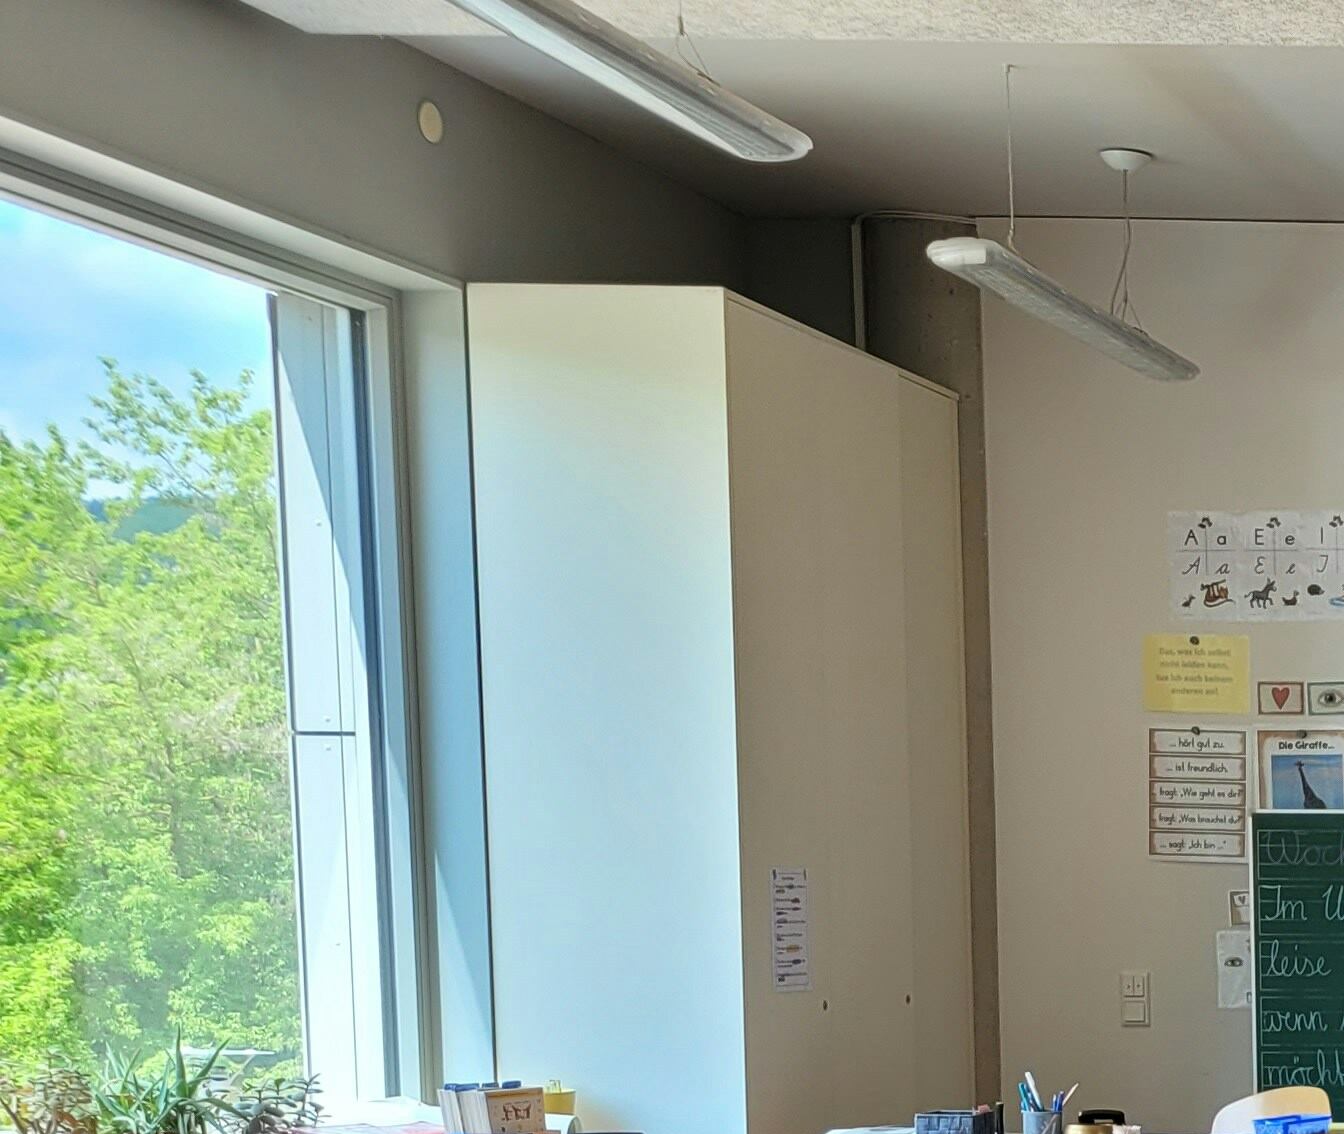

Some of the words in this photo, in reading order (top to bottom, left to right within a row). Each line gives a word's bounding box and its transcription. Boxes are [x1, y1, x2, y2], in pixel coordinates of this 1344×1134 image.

[1184, 528, 1199, 546] A
[1217, 534, 1227, 546] a
[1254, 529, 1265, 546] E
[1285, 534, 1295, 546] e
[1182, 557, 1201, 575] A
[1215, 562, 1230, 575] a
[1254, 557, 1265, 574] E
[1279, 741, 1293, 749] Die
[1264, 885, 1308, 921] Im
[1265, 940, 1332, 977] leise
[1264, 1011, 1328, 1032] wenn
